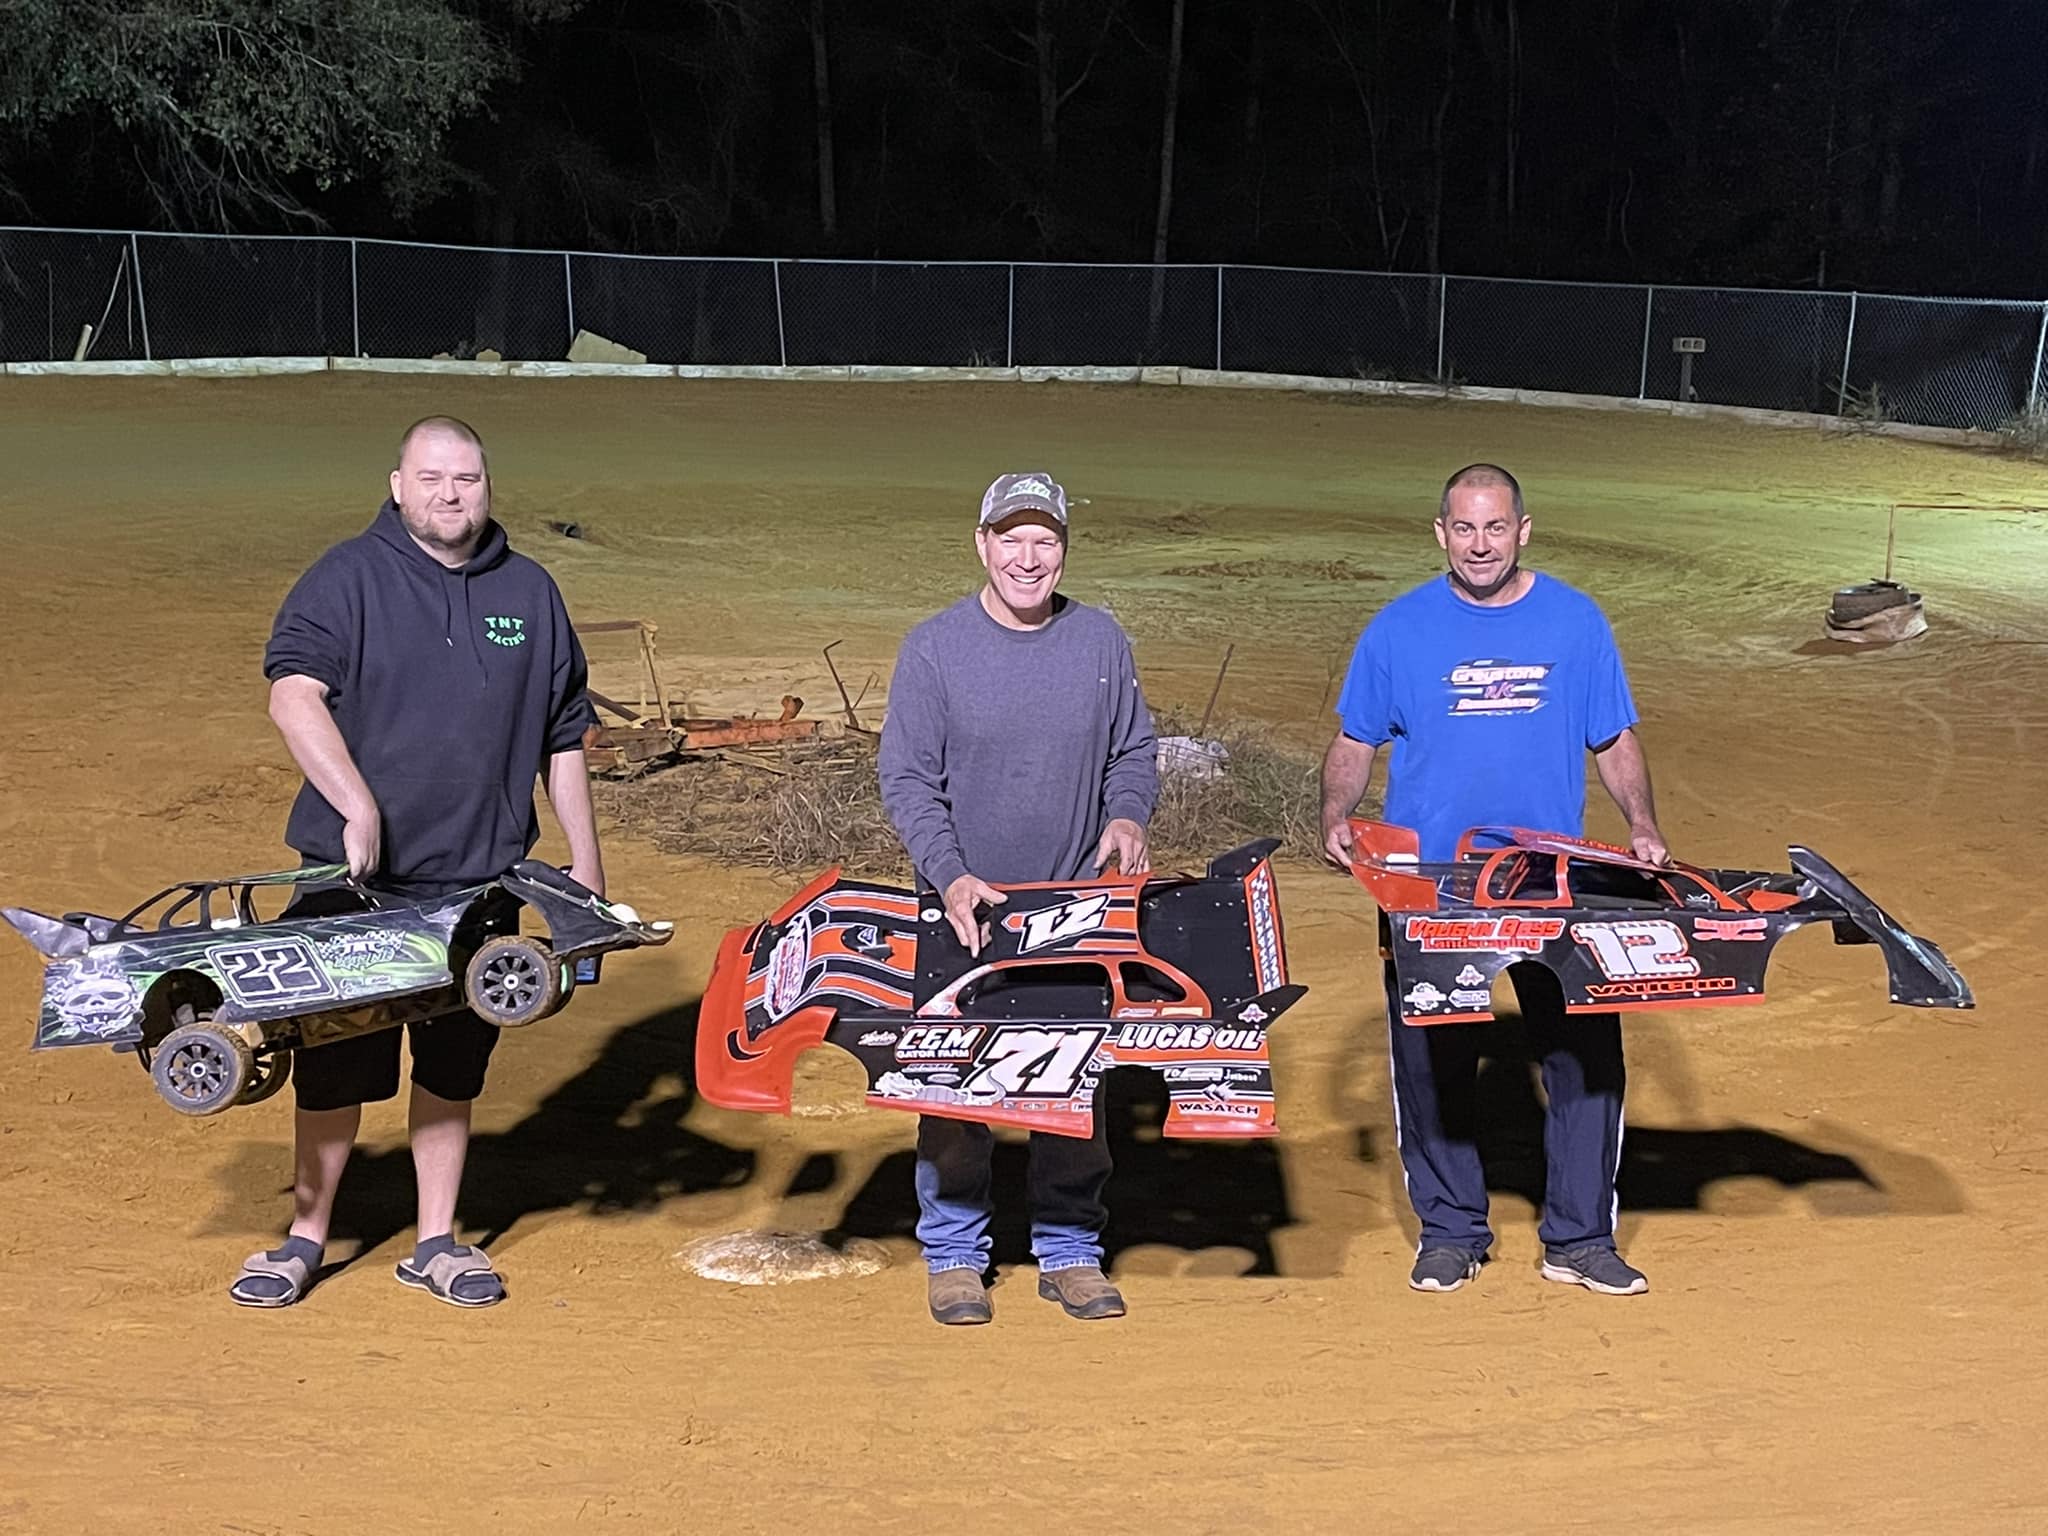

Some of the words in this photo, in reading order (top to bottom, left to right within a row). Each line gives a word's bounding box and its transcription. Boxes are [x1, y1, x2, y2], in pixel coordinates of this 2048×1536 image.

[484, 616, 524, 630] TNT
[1576, 926, 1697, 976] 12
[217, 943, 323, 996] 22
[1585, 977, 1737, 998] VAUGHN
[1117, 1024, 1214, 1050] LUCAS
[1214, 1028, 1263, 1051] OIL
[897, 1049, 936, 1059] GATOR
[937, 1049, 970, 1058] FARM
[966, 1030, 1101, 1094] 71
[1178, 1103, 1259, 1115] WASATCH
